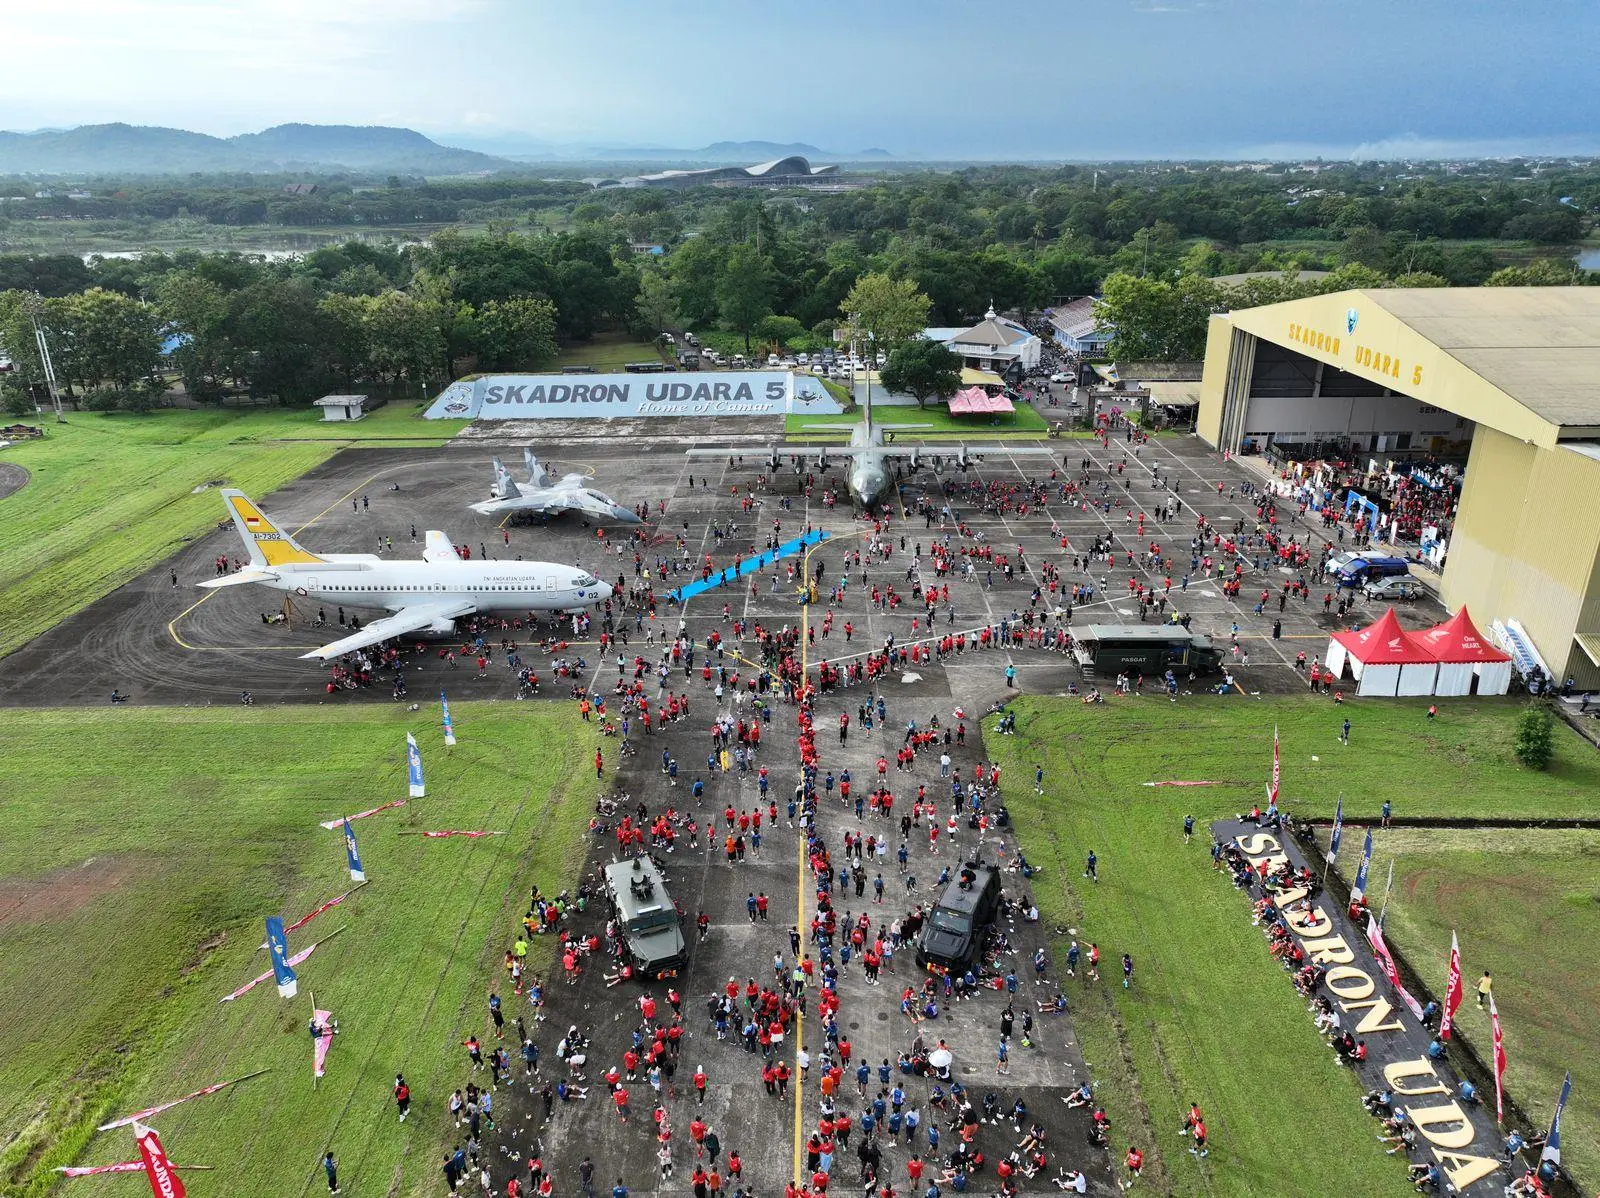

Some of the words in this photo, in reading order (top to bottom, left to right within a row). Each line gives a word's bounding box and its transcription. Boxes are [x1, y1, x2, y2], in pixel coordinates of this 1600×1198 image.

[1288, 323, 1340, 356] SKADRON
[1355, 345, 1400, 379] UDARA
[1412, 365, 1423, 386] 5
[485, 383, 630, 404] SKADRON
[645, 381, 754, 402] UDARA
[765, 381, 785, 401] 5
[637, 401, 688, 413] Home
[693, 401, 712, 416] of
[715, 400, 774, 414] Camar
[588, 591, 599, 600] 02
